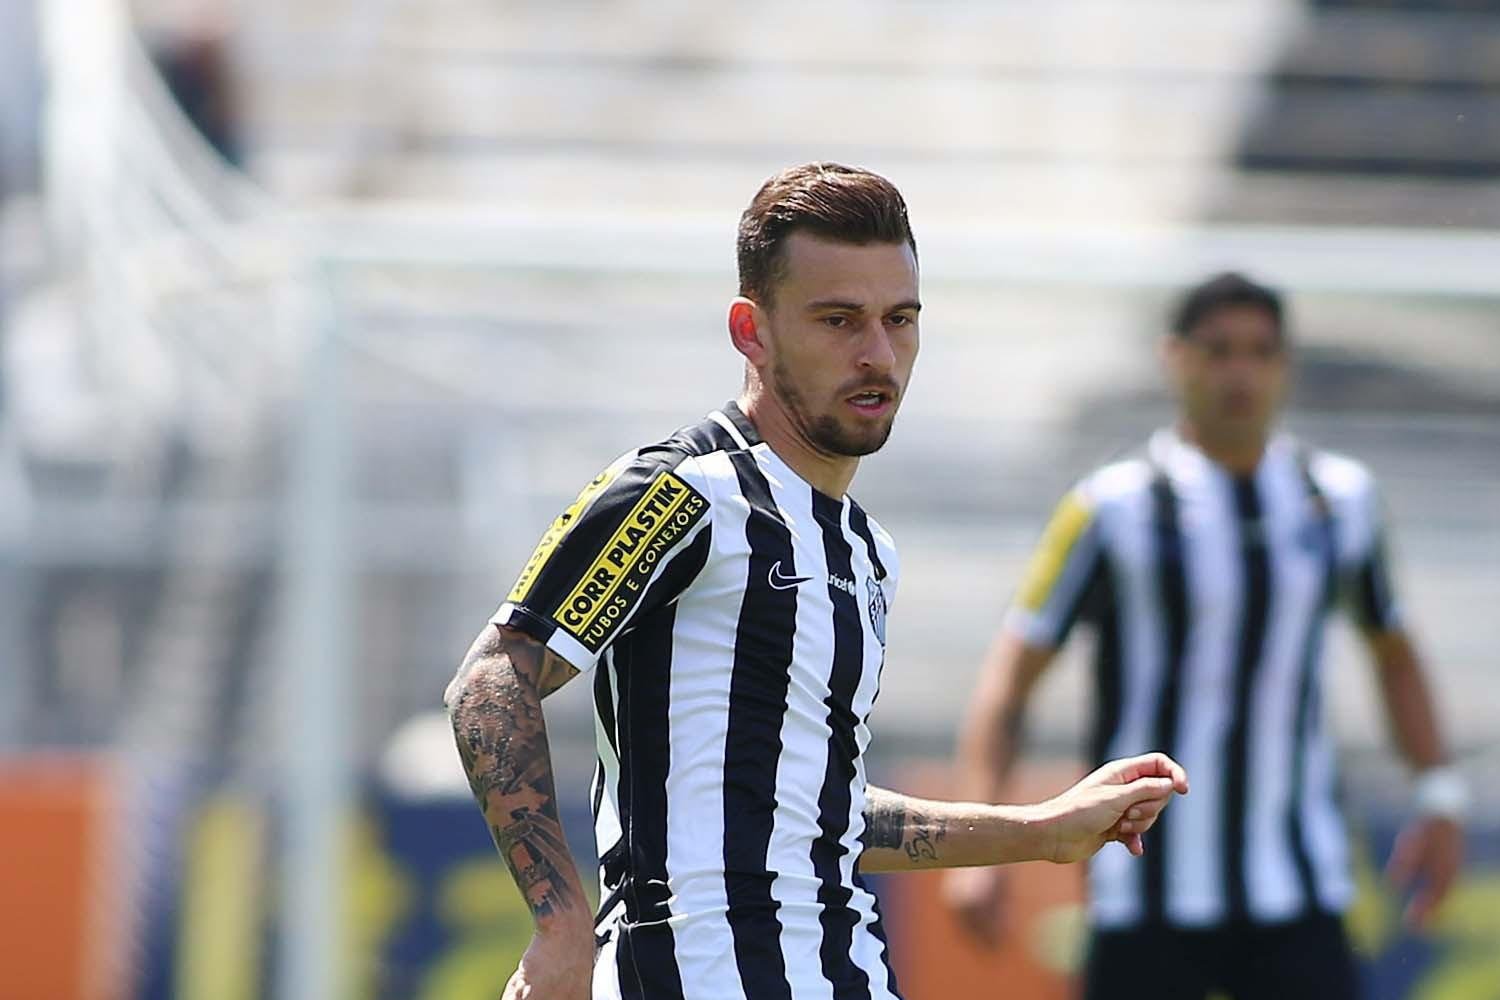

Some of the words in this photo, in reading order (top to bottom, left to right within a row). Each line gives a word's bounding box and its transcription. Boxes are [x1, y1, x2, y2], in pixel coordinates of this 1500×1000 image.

[563, 567, 617, 627] CORR
[607, 479, 683, 569] PLASTIK
[583, 596, 628, 646] TUBOS
[626, 577, 640, 592] E
[638, 495, 704, 575] CONEXÕES
